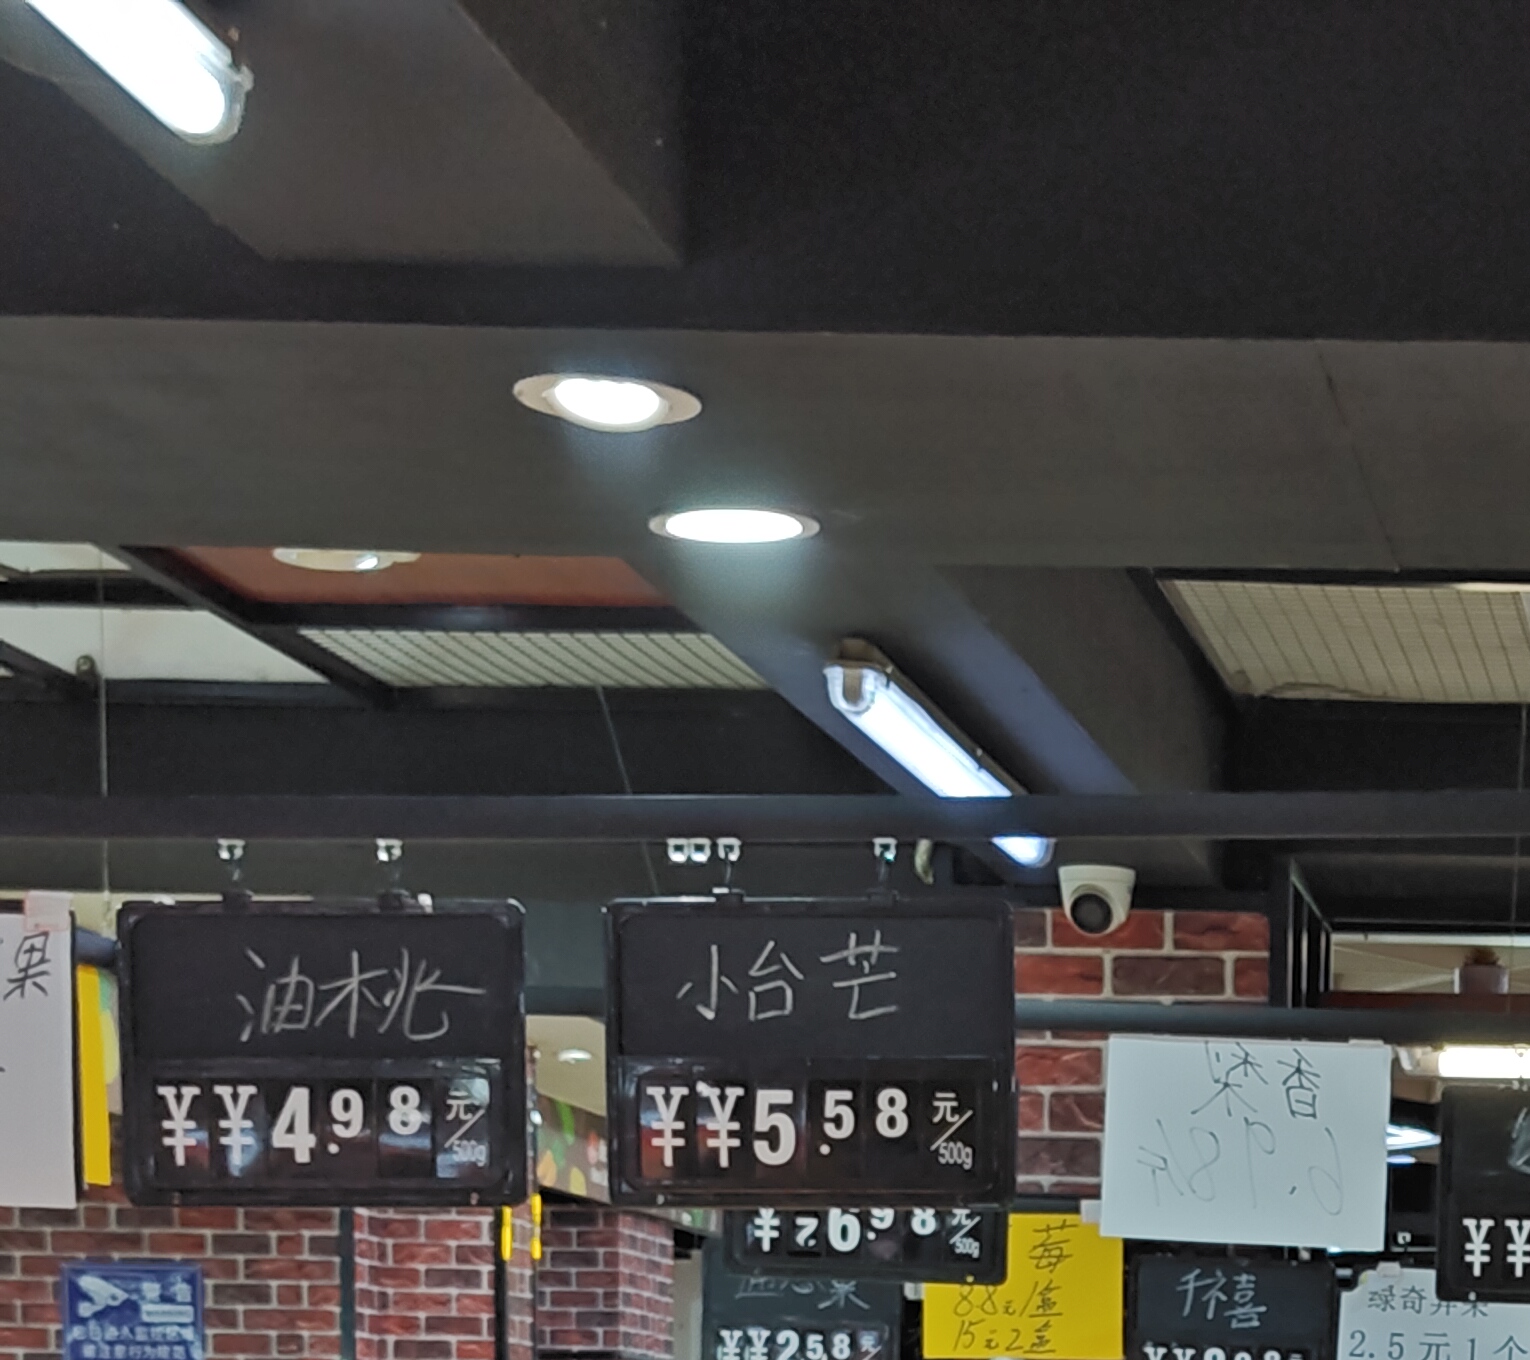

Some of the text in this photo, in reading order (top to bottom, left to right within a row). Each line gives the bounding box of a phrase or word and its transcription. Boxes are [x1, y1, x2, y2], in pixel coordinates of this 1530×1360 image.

[236, 947, 487, 1043] 油桃
[676, 929, 900, 1021] 小台芒
